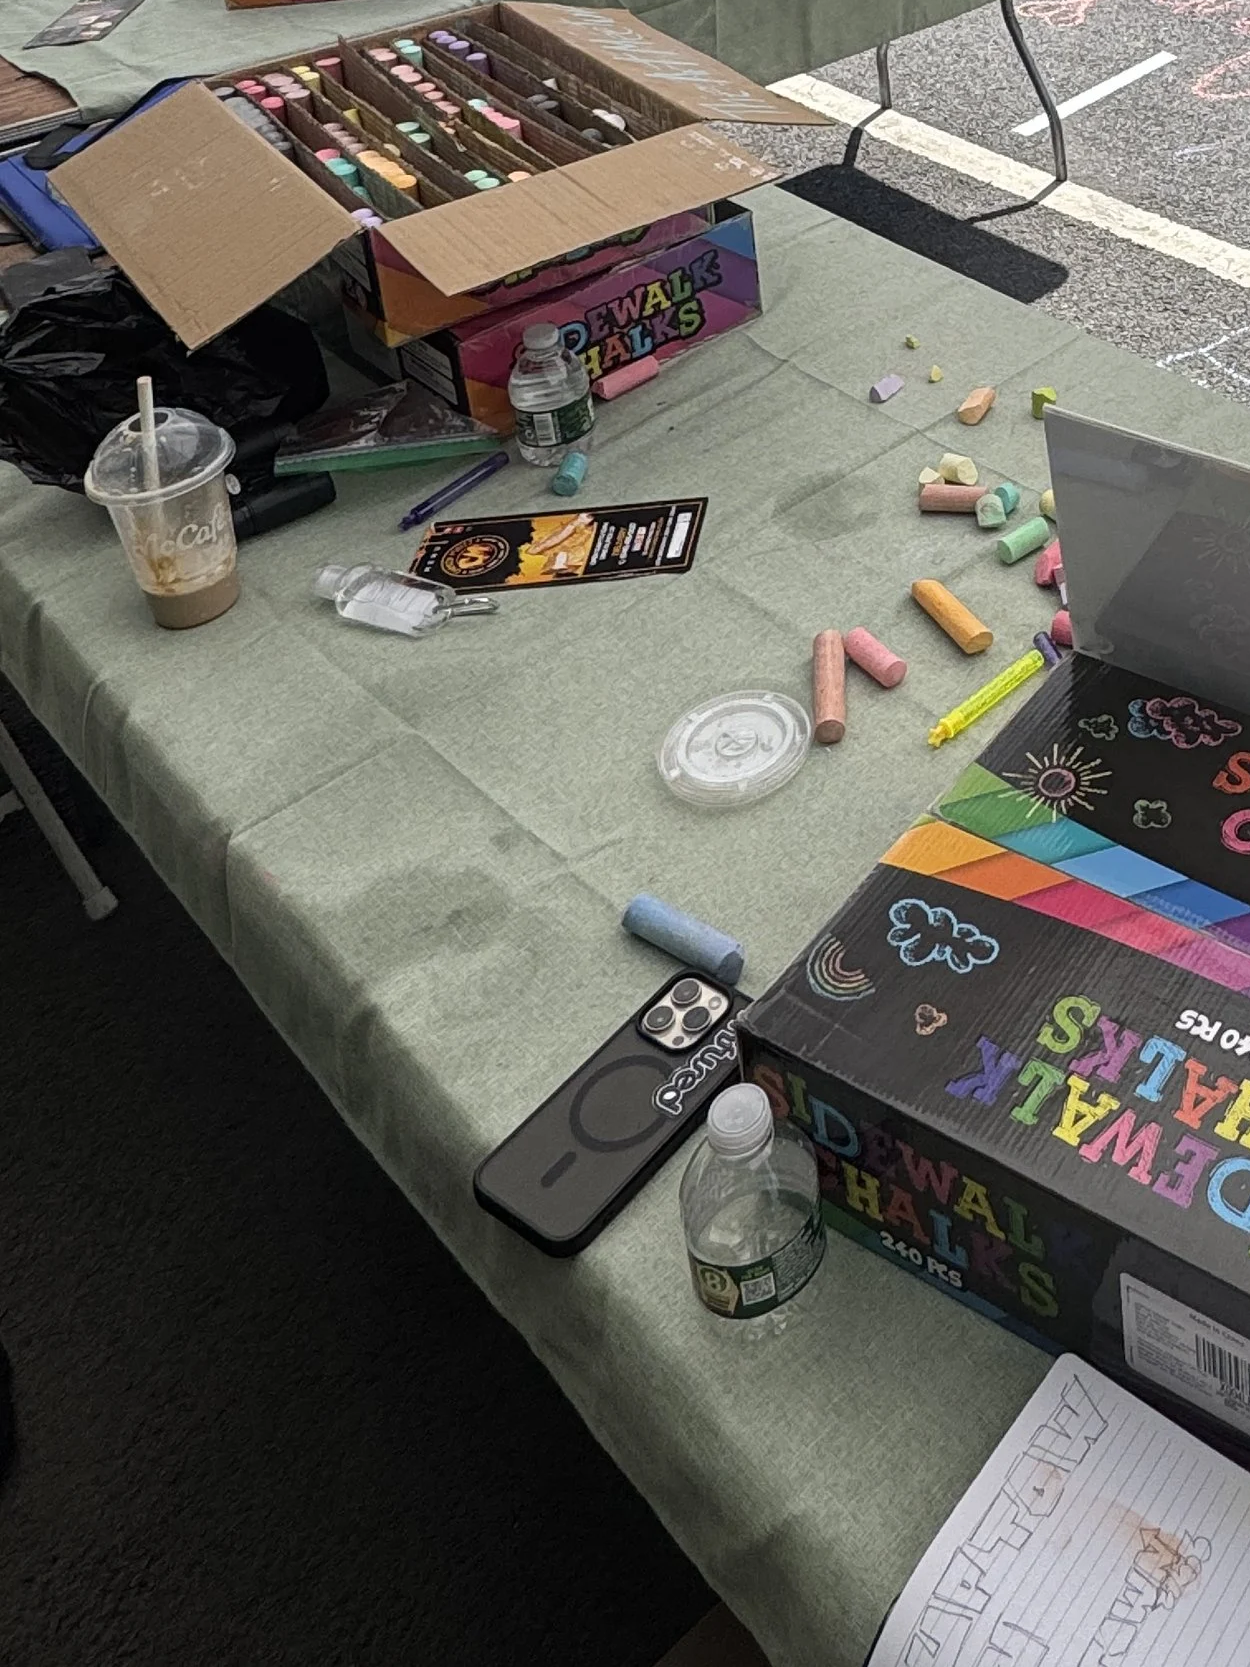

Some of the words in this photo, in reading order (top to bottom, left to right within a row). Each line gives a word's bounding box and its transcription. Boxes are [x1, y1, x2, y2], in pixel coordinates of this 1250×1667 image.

[580, 300, 702, 381] HALKS
[1174, 1008, 1224, 1043] PCS
[878, 1229, 924, 1267] 240
[925, 1253, 964, 1289] PCS
